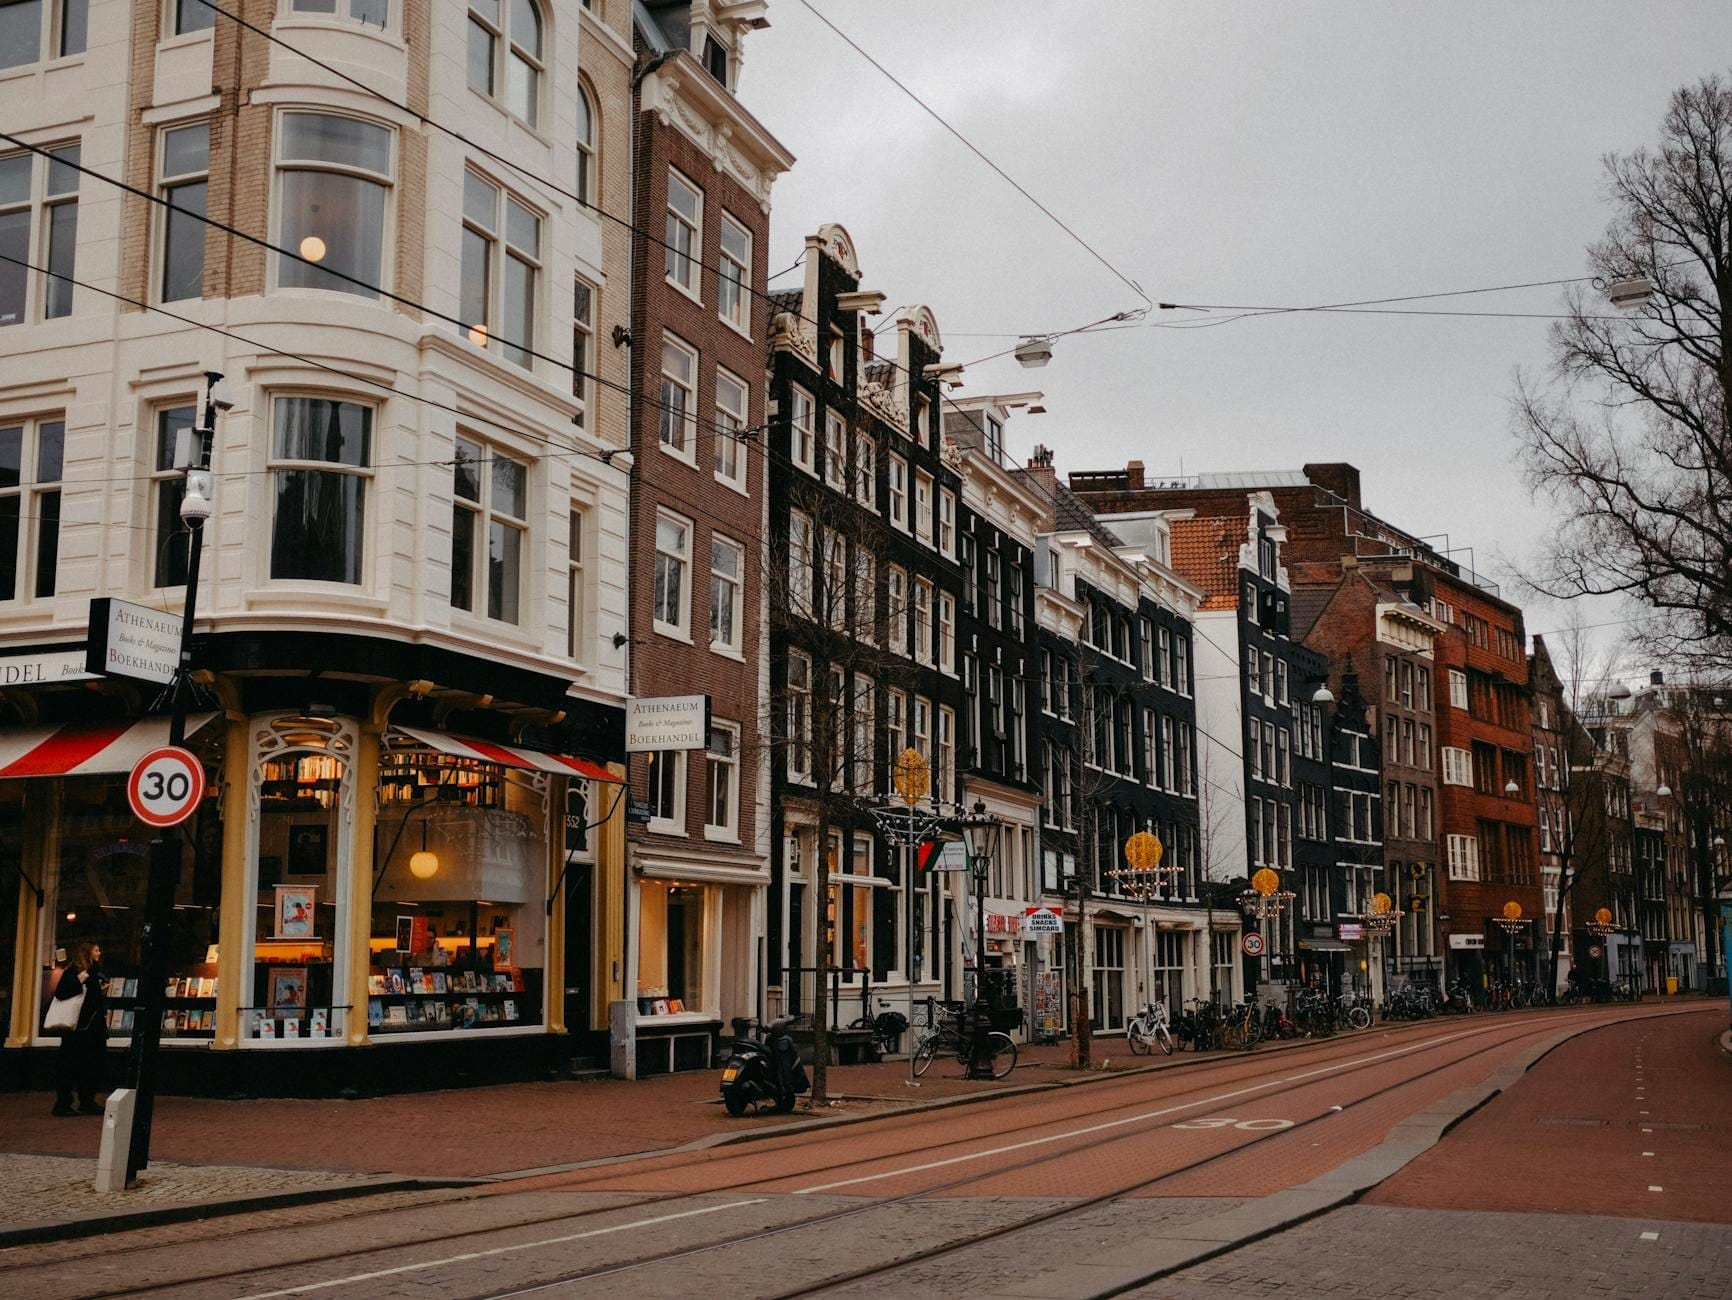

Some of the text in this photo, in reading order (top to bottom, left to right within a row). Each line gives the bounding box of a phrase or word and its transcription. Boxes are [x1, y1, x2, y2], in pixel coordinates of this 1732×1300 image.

[115, 608, 183, 638] ATHENAEUM
[109, 647, 177, 675] BOEKHANDE
[0, 662, 86, 684] DEL Book
[633, 702, 698, 714] ATHENAEUM
[630, 732, 700, 745] BOEKHANDEL
[142, 771, 189, 802] 30
[566, 814, 580, 829] 352
[1247, 939, 1261, 949] 30
[1171, 1118, 1295, 1130] 30
